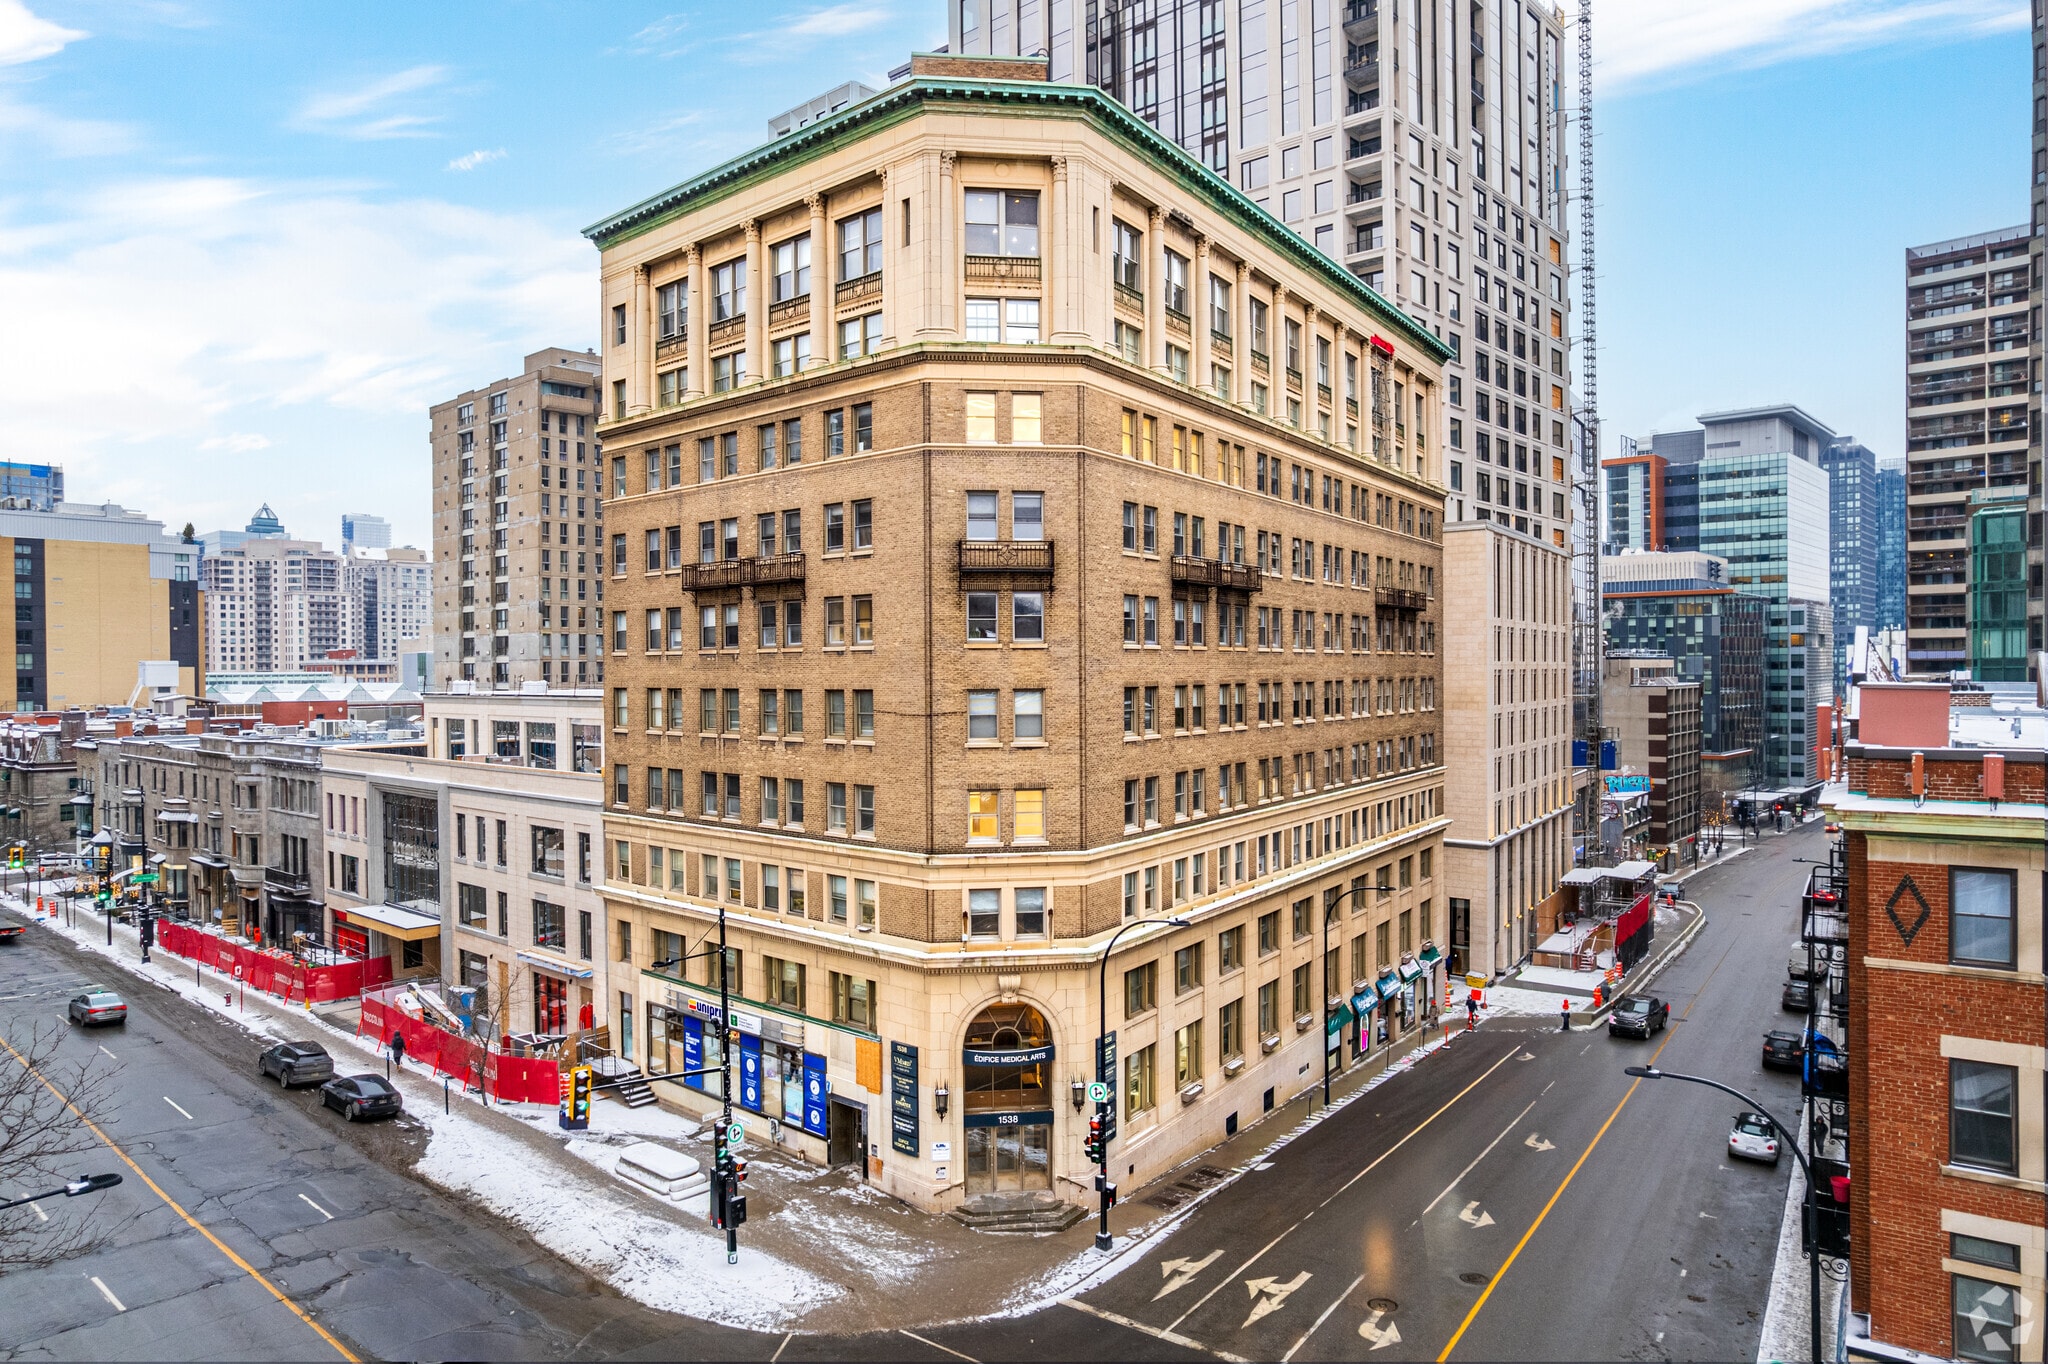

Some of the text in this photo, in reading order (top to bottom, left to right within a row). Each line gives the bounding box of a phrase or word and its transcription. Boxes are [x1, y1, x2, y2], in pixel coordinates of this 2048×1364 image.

[696, 1001, 723, 1020] unipri
[974, 1052, 1046, 1063] ÉDIFICE MEDICAL ARTS
[998, 1115, 1018, 1124] 1538
